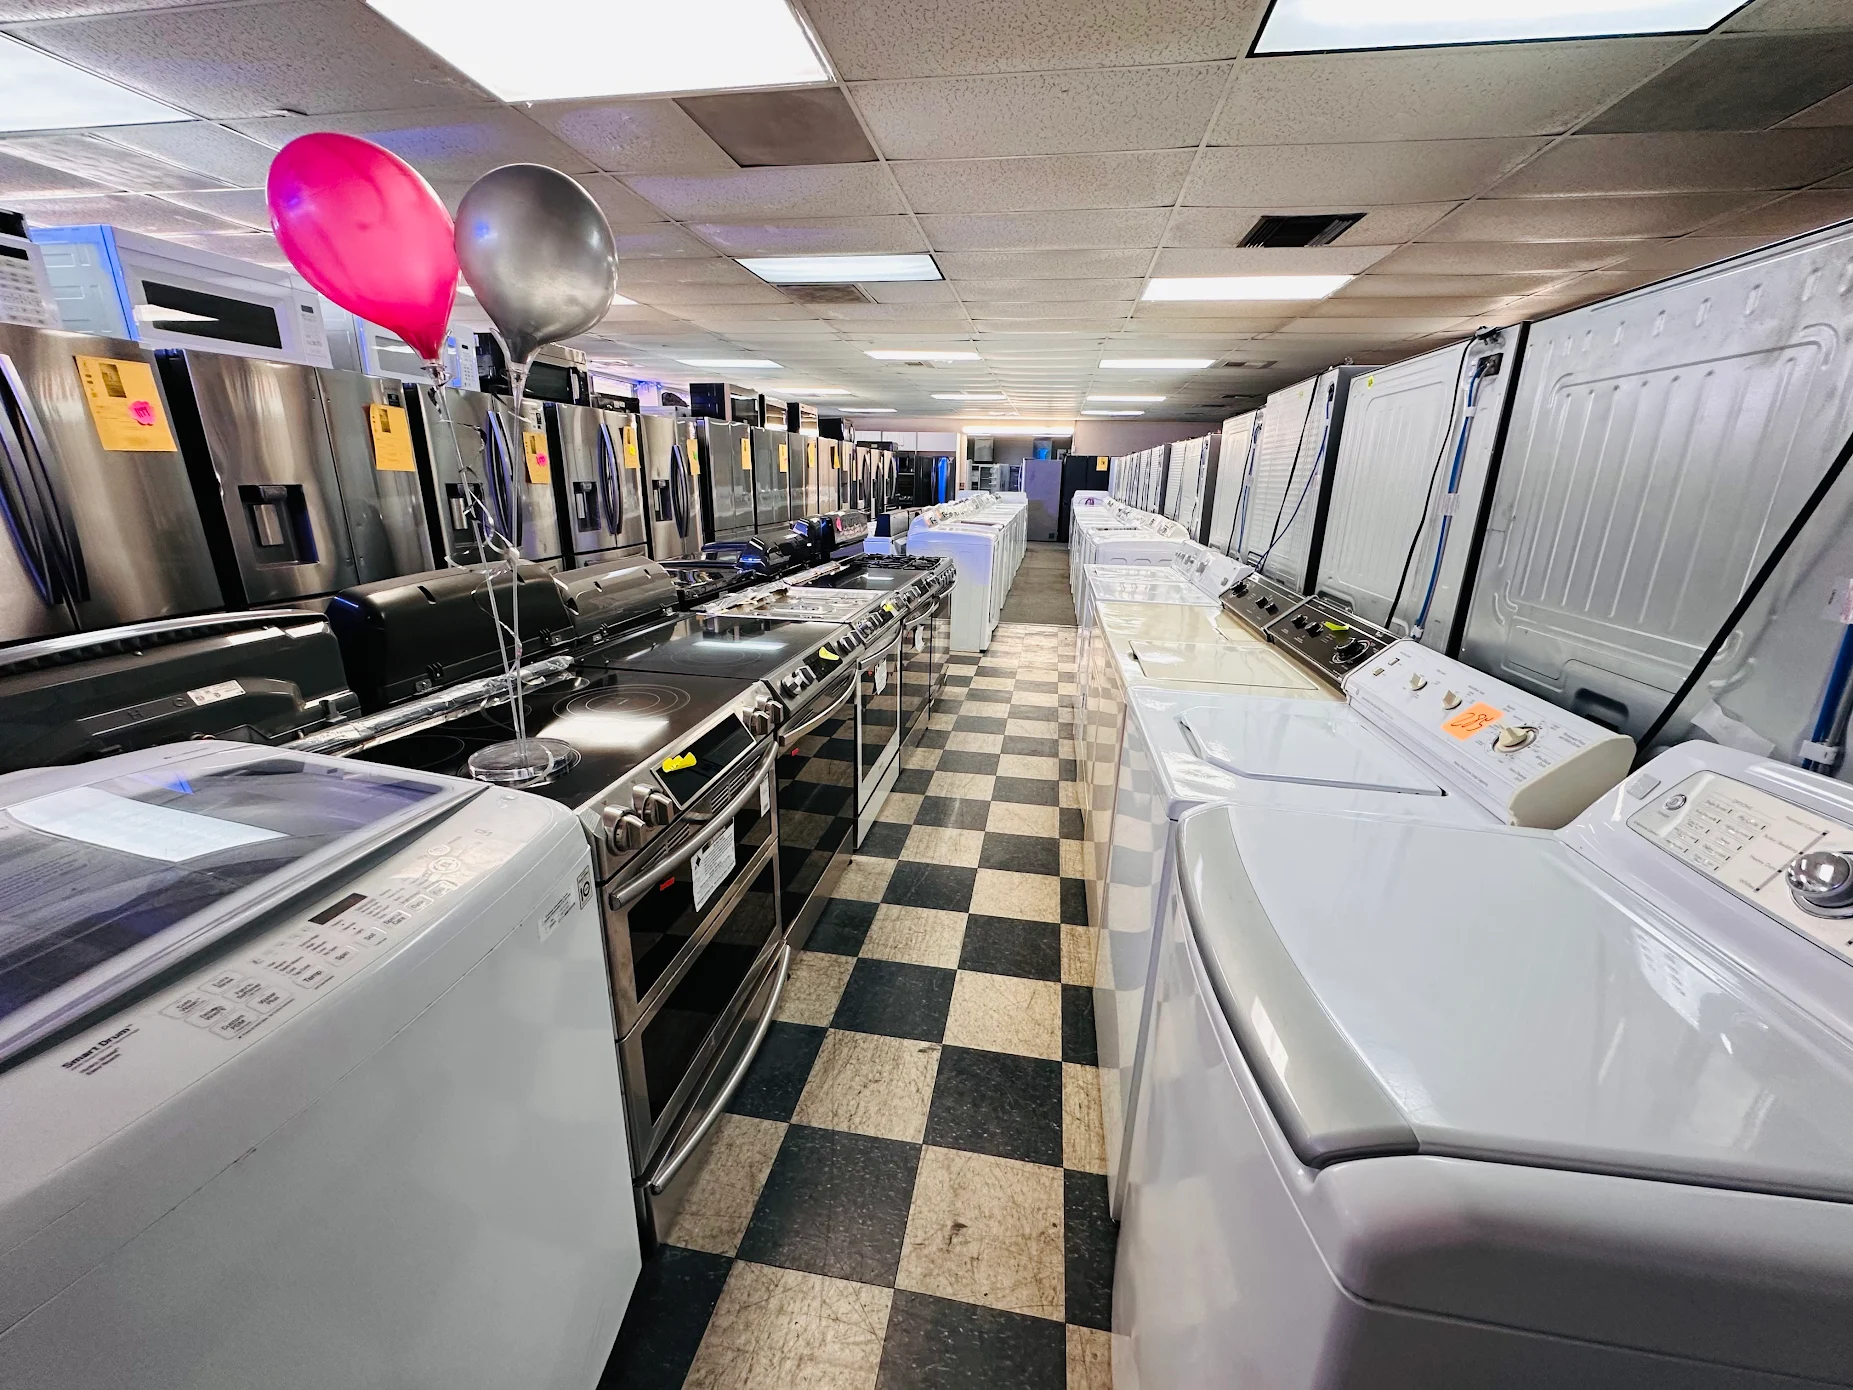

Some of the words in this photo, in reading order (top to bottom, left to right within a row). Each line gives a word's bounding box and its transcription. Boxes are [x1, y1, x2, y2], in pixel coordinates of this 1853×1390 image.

[302, 970, 323, 984] Temp
[61, 1046, 100, 1069] Smart
[98, 1027, 131, 1046] Drum
